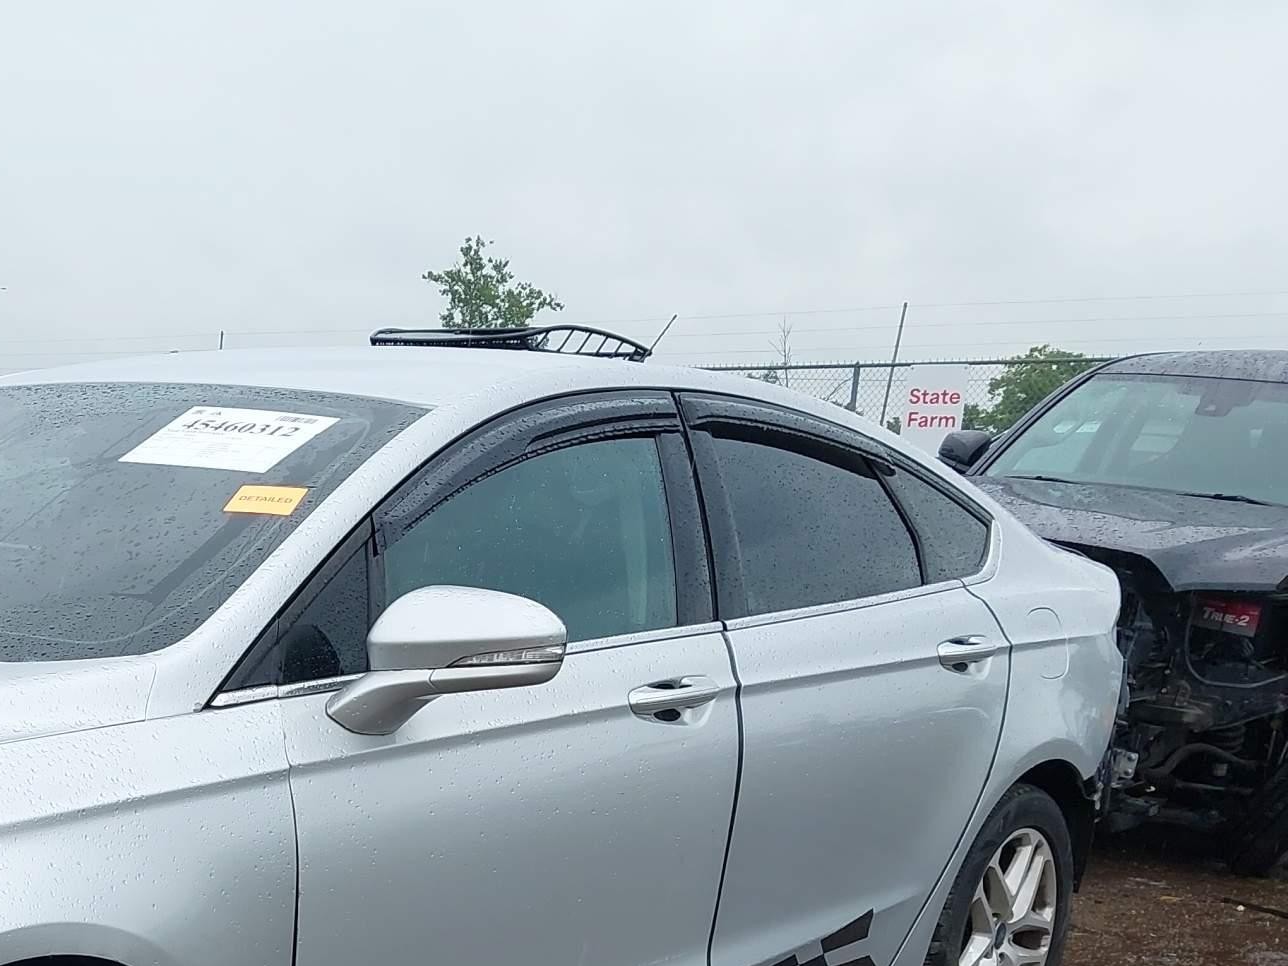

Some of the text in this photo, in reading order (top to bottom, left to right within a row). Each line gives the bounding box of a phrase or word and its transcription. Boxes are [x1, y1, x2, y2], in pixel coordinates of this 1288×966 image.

[909, 388, 961, 405] State
[182, 419, 300, 437] 45460312
[907, 412, 956, 428] Farm
[239, 495, 293, 504] DETAILED
